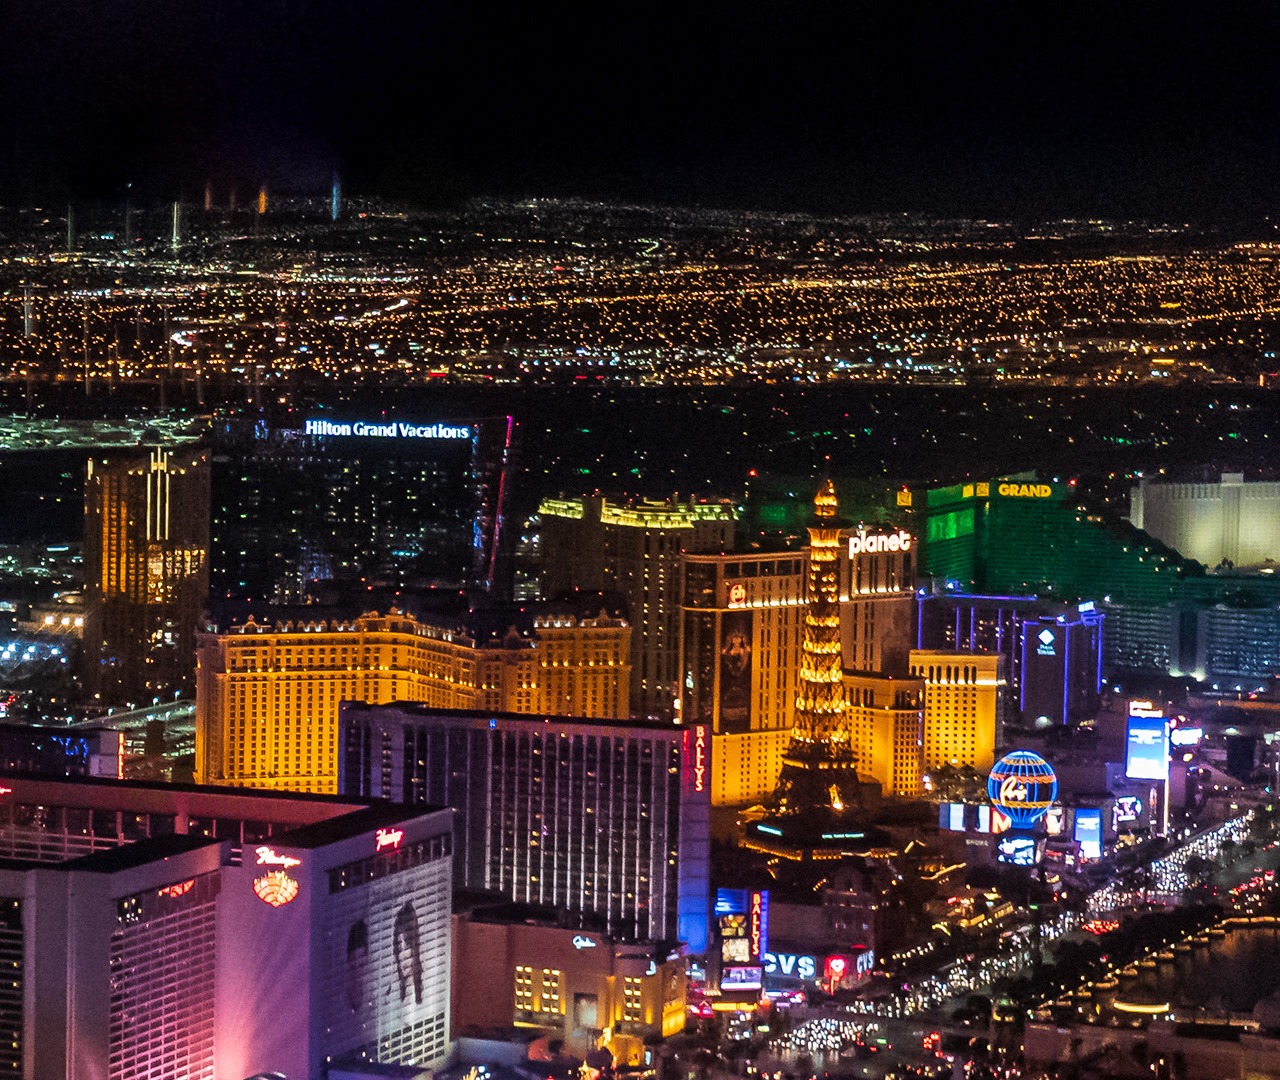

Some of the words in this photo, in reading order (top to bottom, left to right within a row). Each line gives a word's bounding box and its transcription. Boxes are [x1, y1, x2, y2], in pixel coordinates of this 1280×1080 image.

[305, 420, 351, 436] Hilton
[353, 421, 397, 437] Grand
[399, 422, 470, 439] Vacations
[998, 483, 1052, 498] GRAND
[848, 529, 911, 561] planet
[764, 952, 815, 979] CVS
[856, 950, 875, 975] CVS
